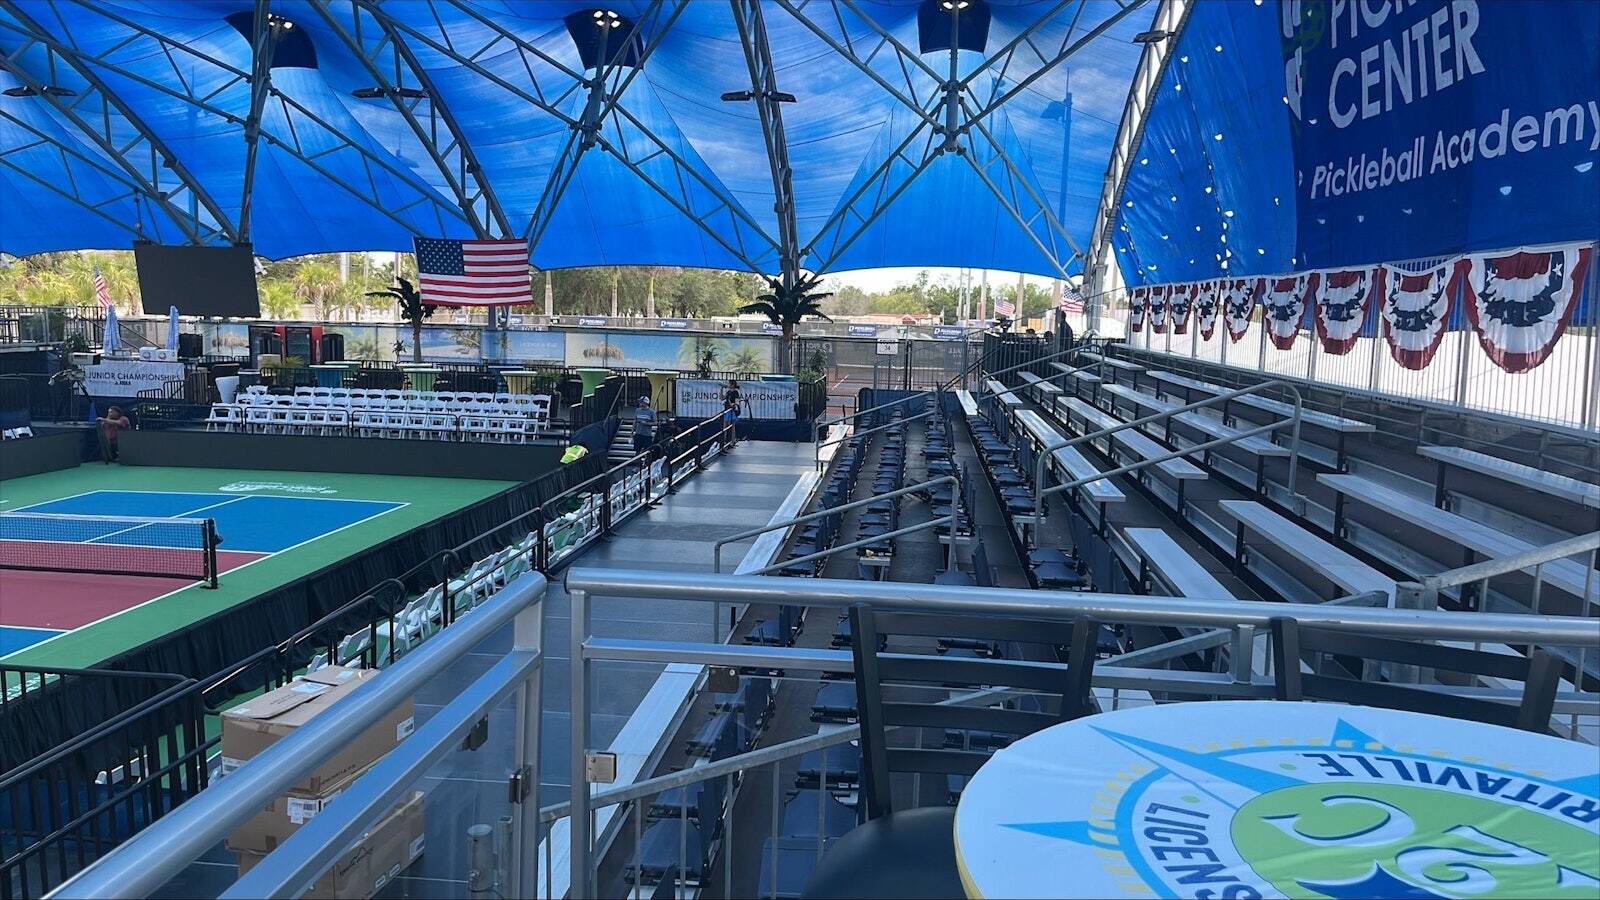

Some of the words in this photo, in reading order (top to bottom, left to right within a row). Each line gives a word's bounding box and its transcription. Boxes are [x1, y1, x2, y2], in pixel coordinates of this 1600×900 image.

[1329, 0, 1486, 129] CENTER
[1311, 136, 1425, 200] Pickleball
[89, 371, 116, 380] JUNIOR
[117, 372, 181, 381] CHAMPIONSHIPS
[695, 392, 720, 400] JUNIO
[740, 393, 795, 401] AMPIONSHIPS
